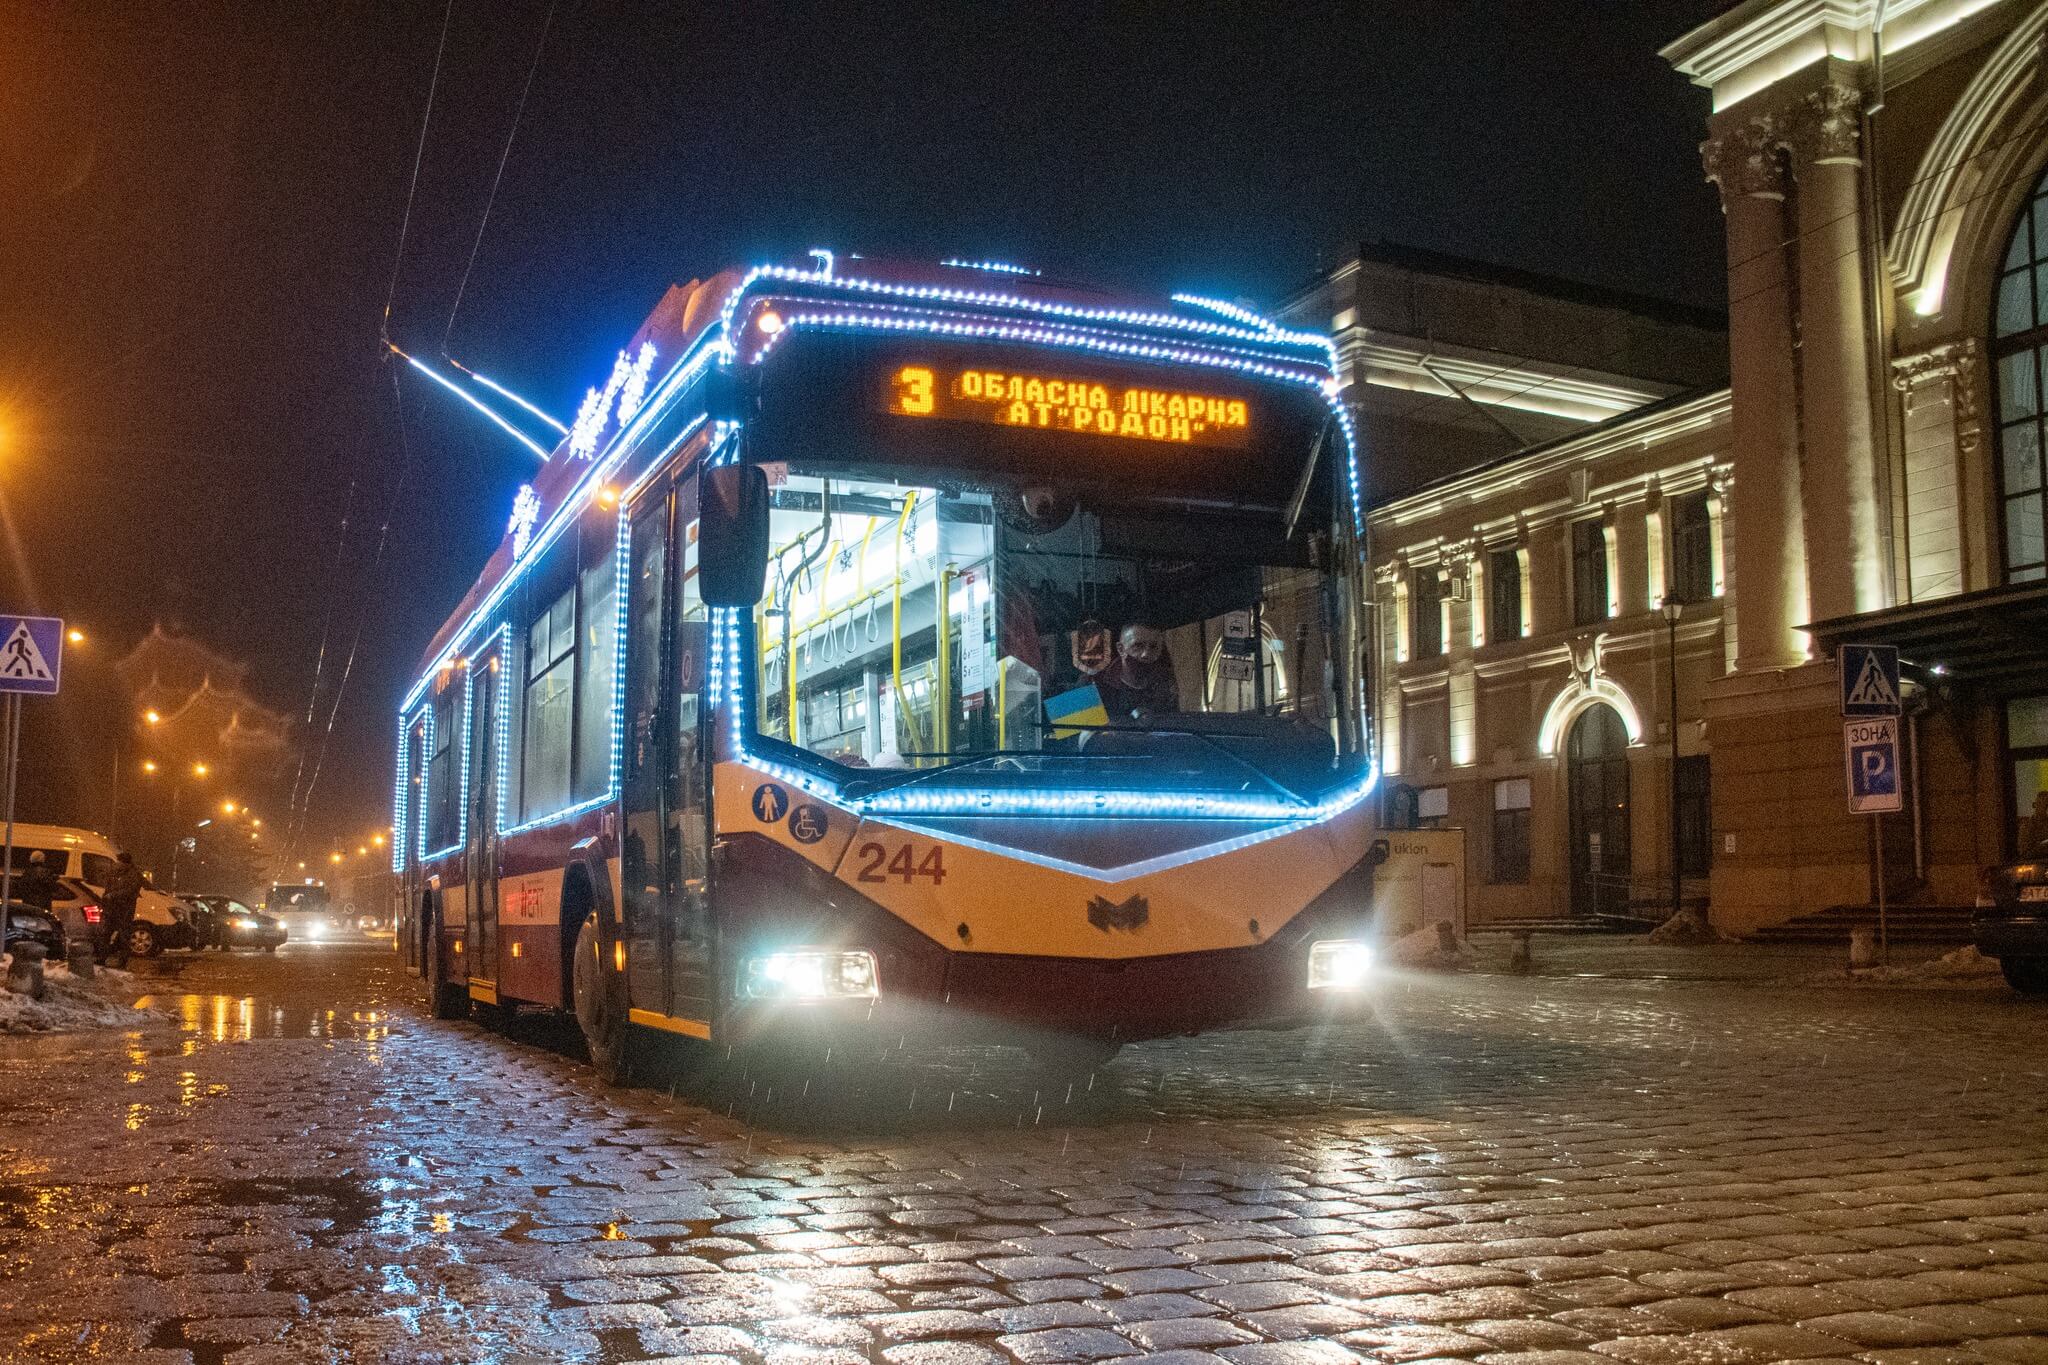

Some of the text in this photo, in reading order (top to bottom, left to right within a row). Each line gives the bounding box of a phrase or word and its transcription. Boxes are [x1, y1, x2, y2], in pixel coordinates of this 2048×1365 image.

[900, 367, 933, 414] 3
[962, 370, 1247, 426] ОБЛАСНА ЛІКАРНЯ
[1851, 725, 1890, 743] ЗОНА
[857, 842, 947, 885] 244
[1394, 842, 1428, 855] uklon
